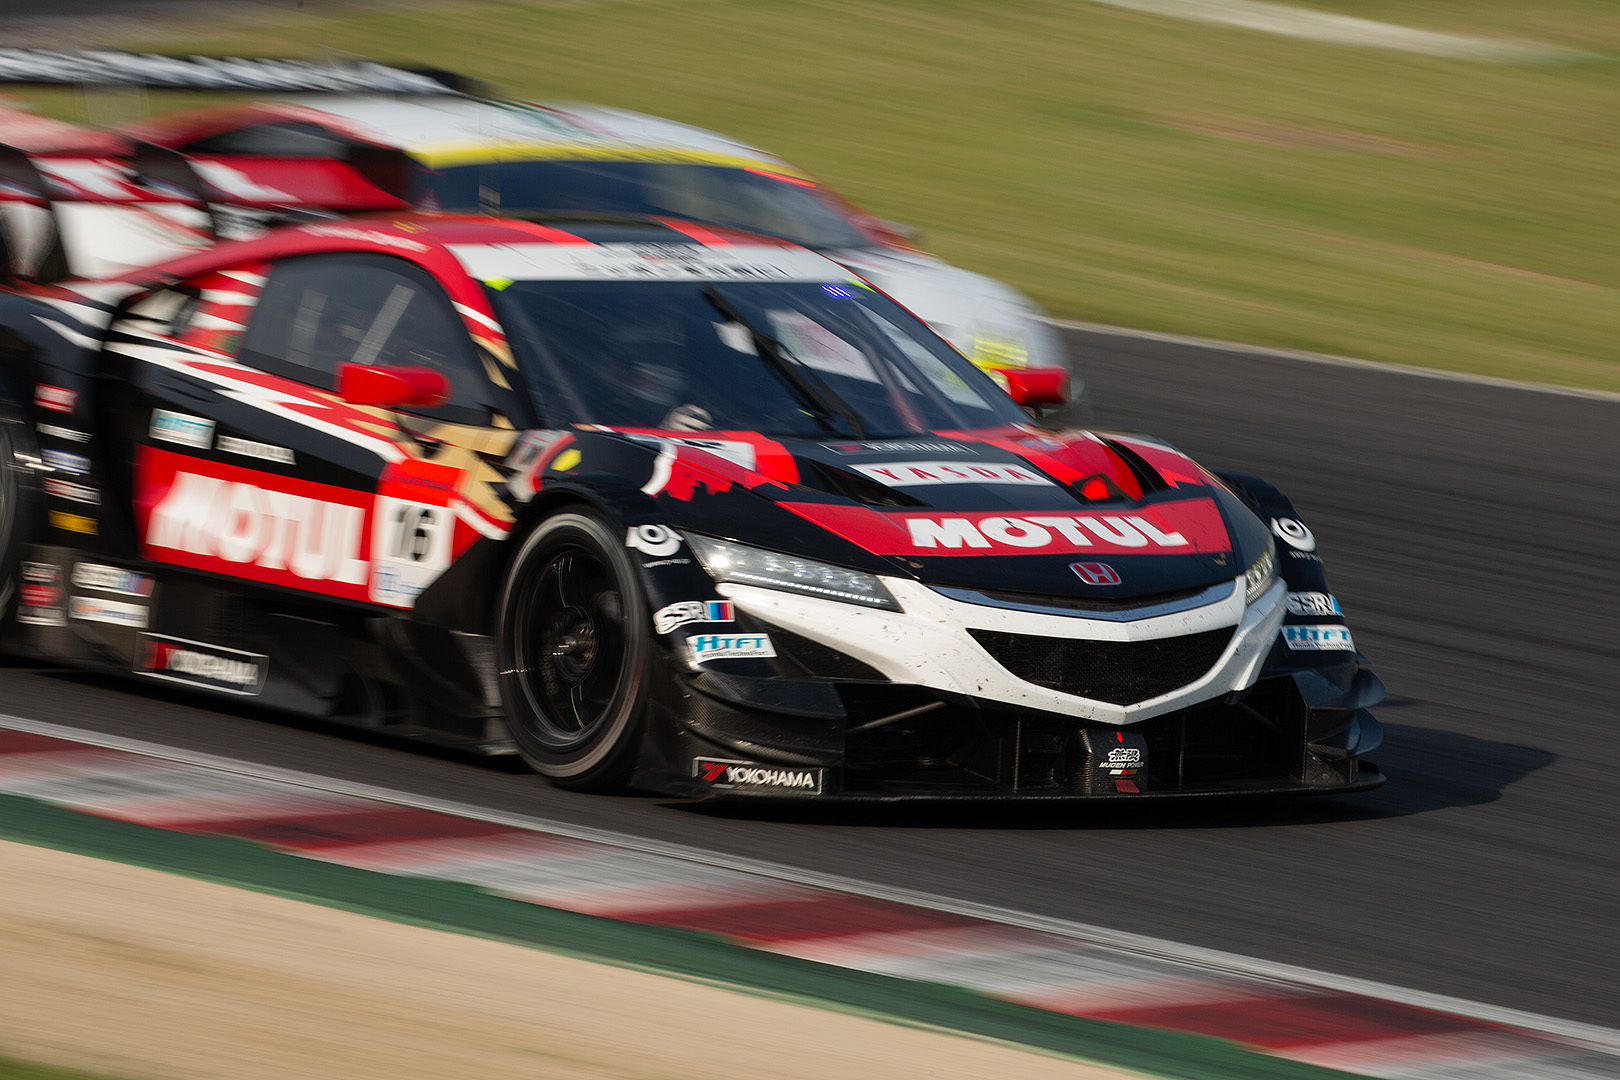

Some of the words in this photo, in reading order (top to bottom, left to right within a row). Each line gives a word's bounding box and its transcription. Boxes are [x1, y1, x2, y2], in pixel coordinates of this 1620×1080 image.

[867, 465, 1039, 482] YASDA
[145, 478, 371, 586] MOTUL
[386, 502, 437, 563] 16
[905, 516, 1190, 549] MOTUL
[697, 635, 768, 653] HTFT
[1098, 761, 1127, 769] MUGEN
[726, 766, 815, 788] YOKOHAMA
